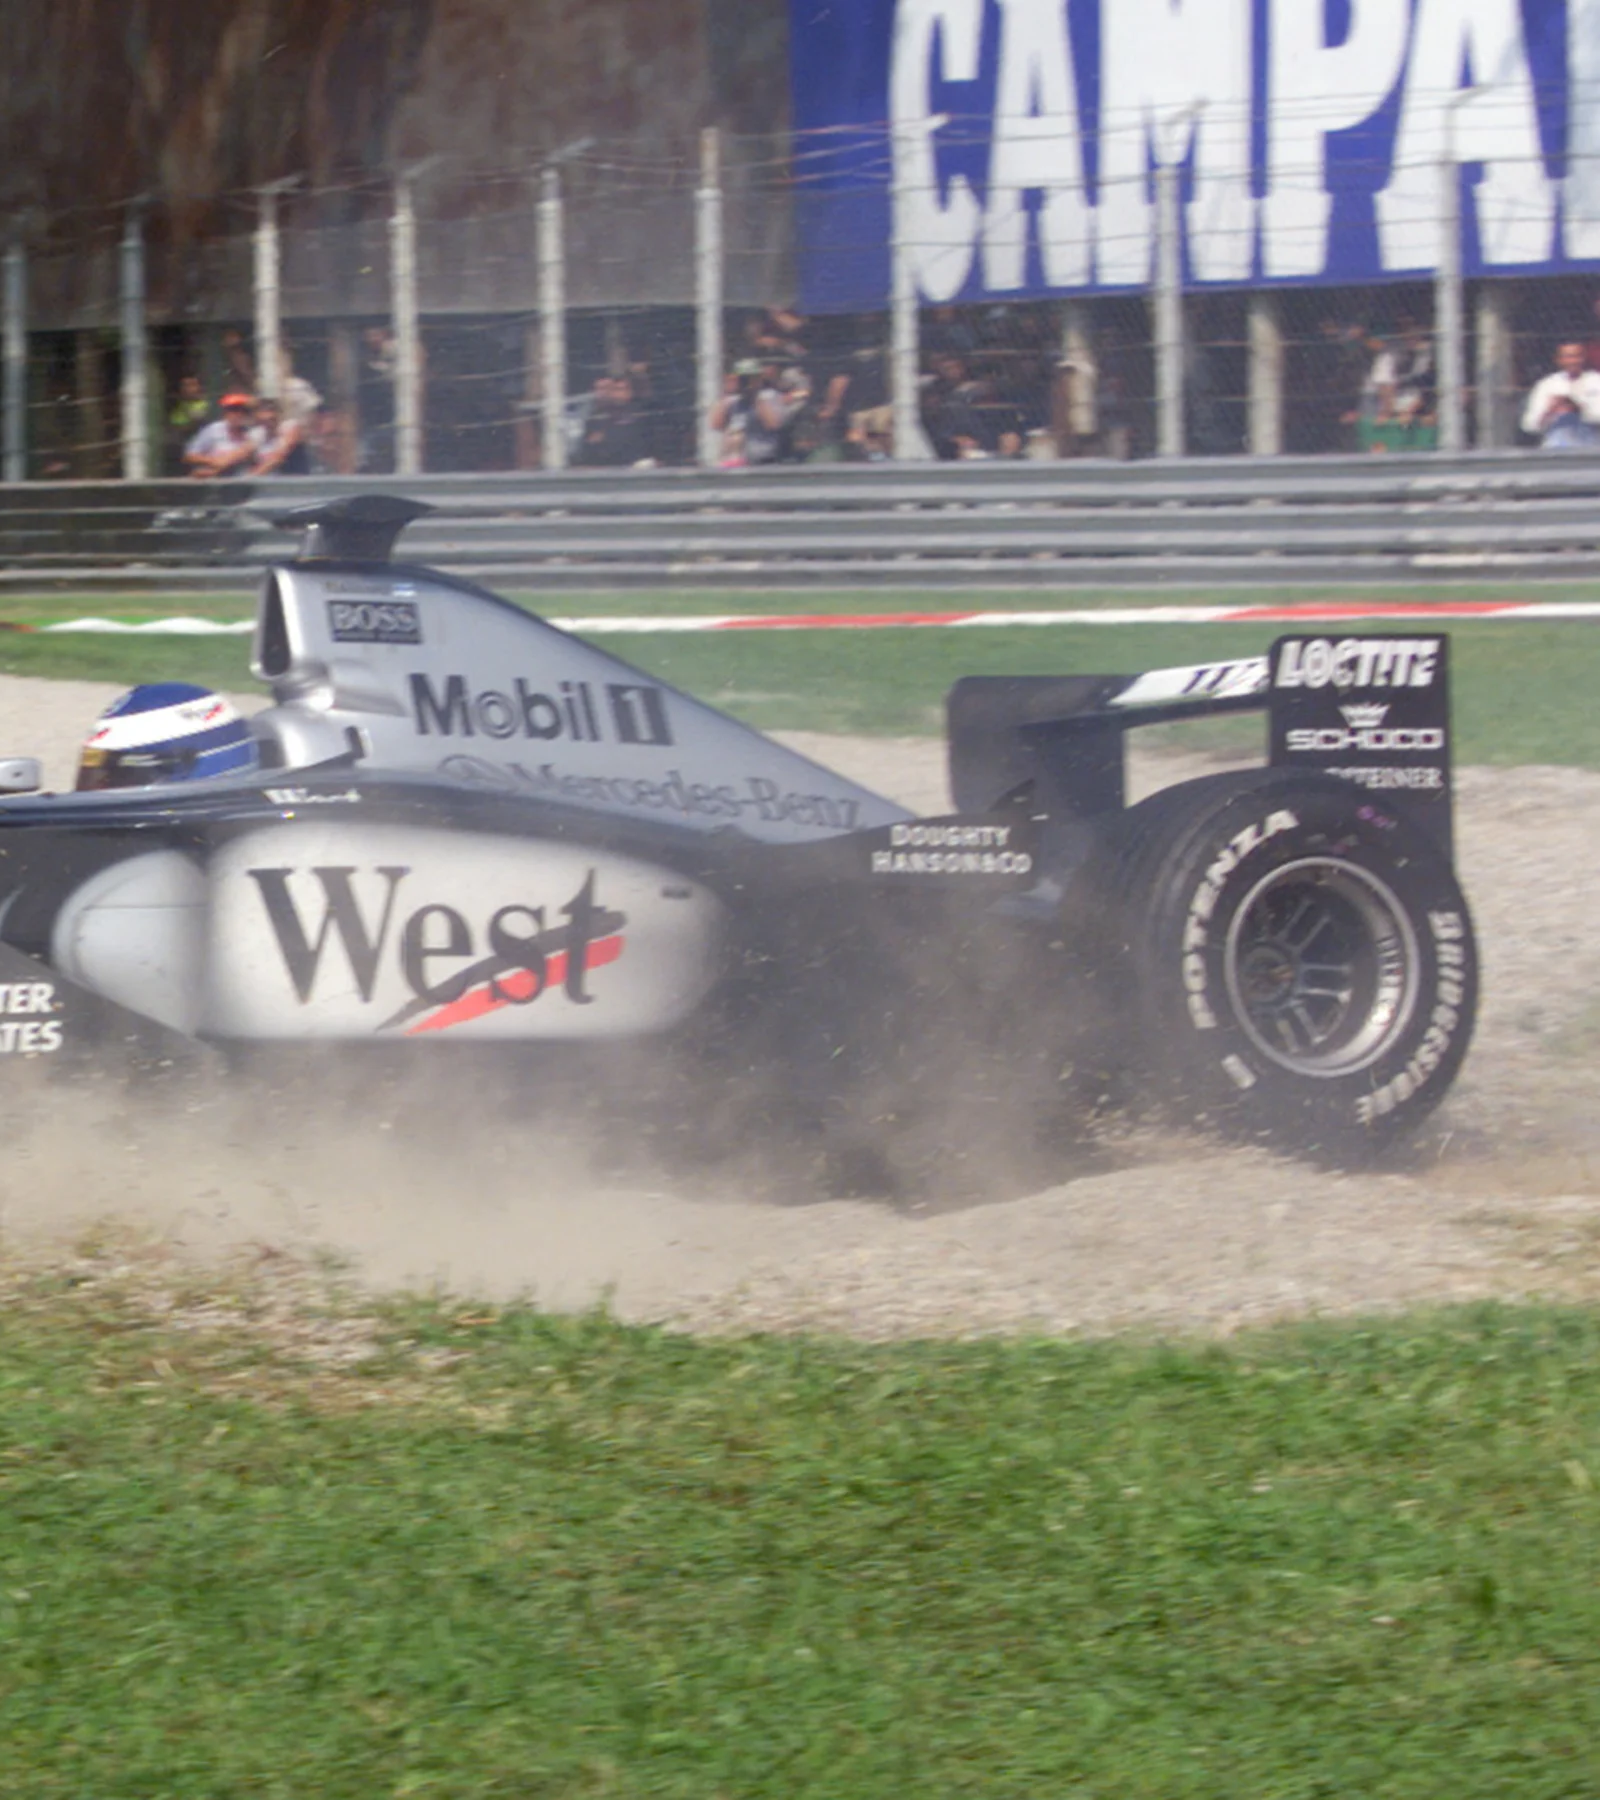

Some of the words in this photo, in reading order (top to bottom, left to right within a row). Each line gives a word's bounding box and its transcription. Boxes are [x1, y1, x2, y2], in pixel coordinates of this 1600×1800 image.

[331, 604, 417, 632] BOSS
[1274, 637, 1441, 689] LOCTITE
[408, 672, 603, 743] Mobil
[505, 762, 870, 831] Mercedes-Benz
[890, 823, 1012, 846] DOUGHTY
[245, 865, 612, 1006] West
[1182, 808, 1300, 1030] POTENZA
[1353, 910, 1465, 1125] BRIDGESTONE
